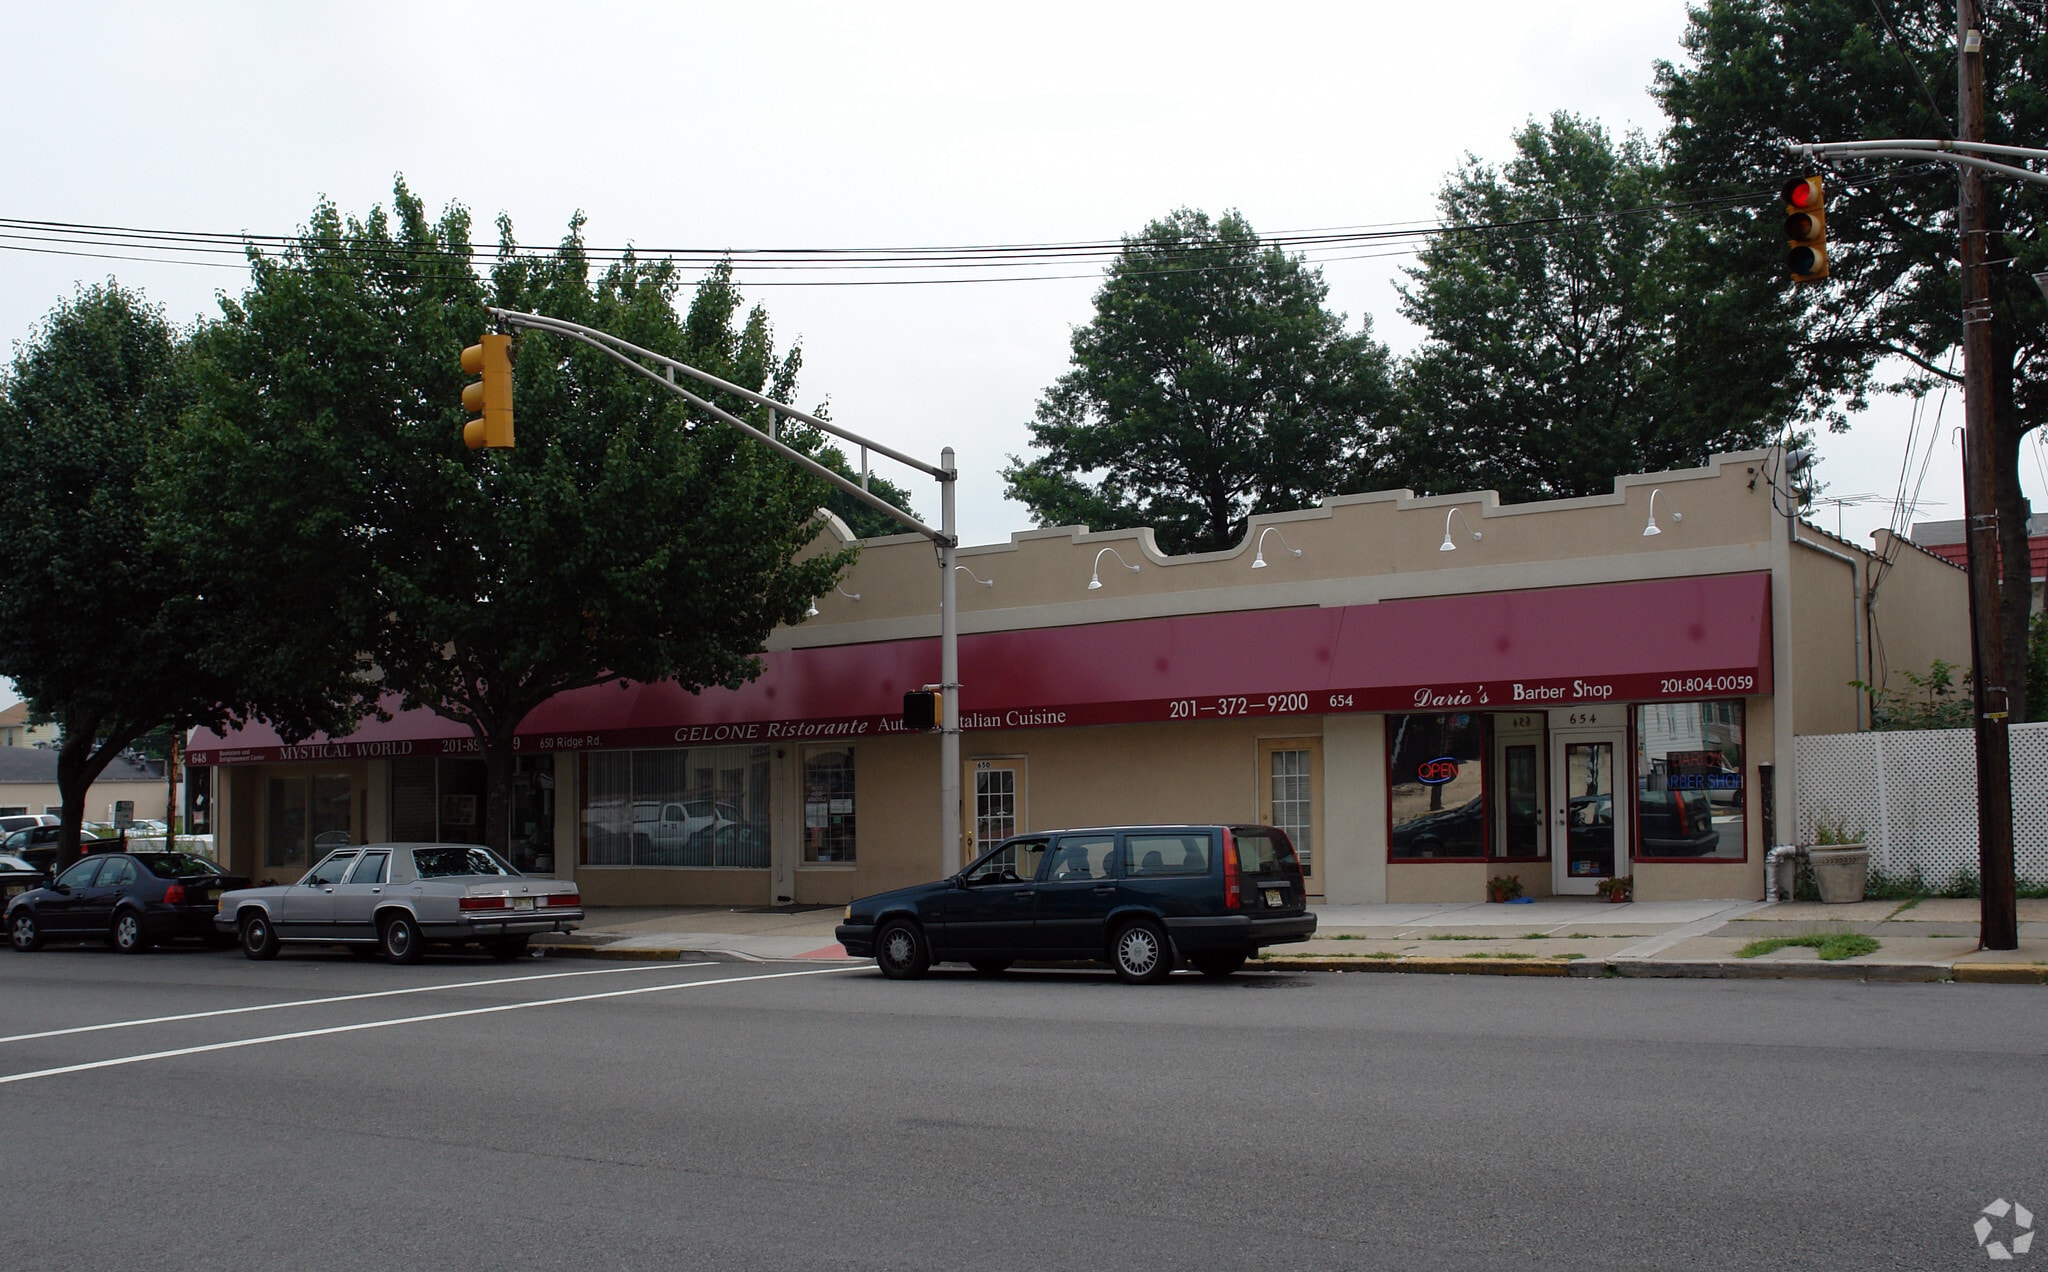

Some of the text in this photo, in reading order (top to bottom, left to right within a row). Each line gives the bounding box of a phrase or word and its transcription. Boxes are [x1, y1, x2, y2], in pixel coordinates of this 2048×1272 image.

[1660, 675, 1753, 693] 201-804-0059
[1329, 694, 1354, 707] 654
[1413, 679, 1613, 708] Dario's Barber Shop
[674, 724, 760, 742] GELONE
[766, 719, 869, 738] Ristorante
[960, 713, 1001, 728] talian
[1006, 709, 1067, 726] Cuisine
[1569, 713, 1597, 725] 654
[539, 735, 602, 749] 650 Ridge Rd.
[191, 752, 207, 764] 648
[280, 741, 412, 760] MYSTICAL WORLD
[1418, 762, 1460, 778] OPEN
[1667, 774, 1704, 789] RBER
